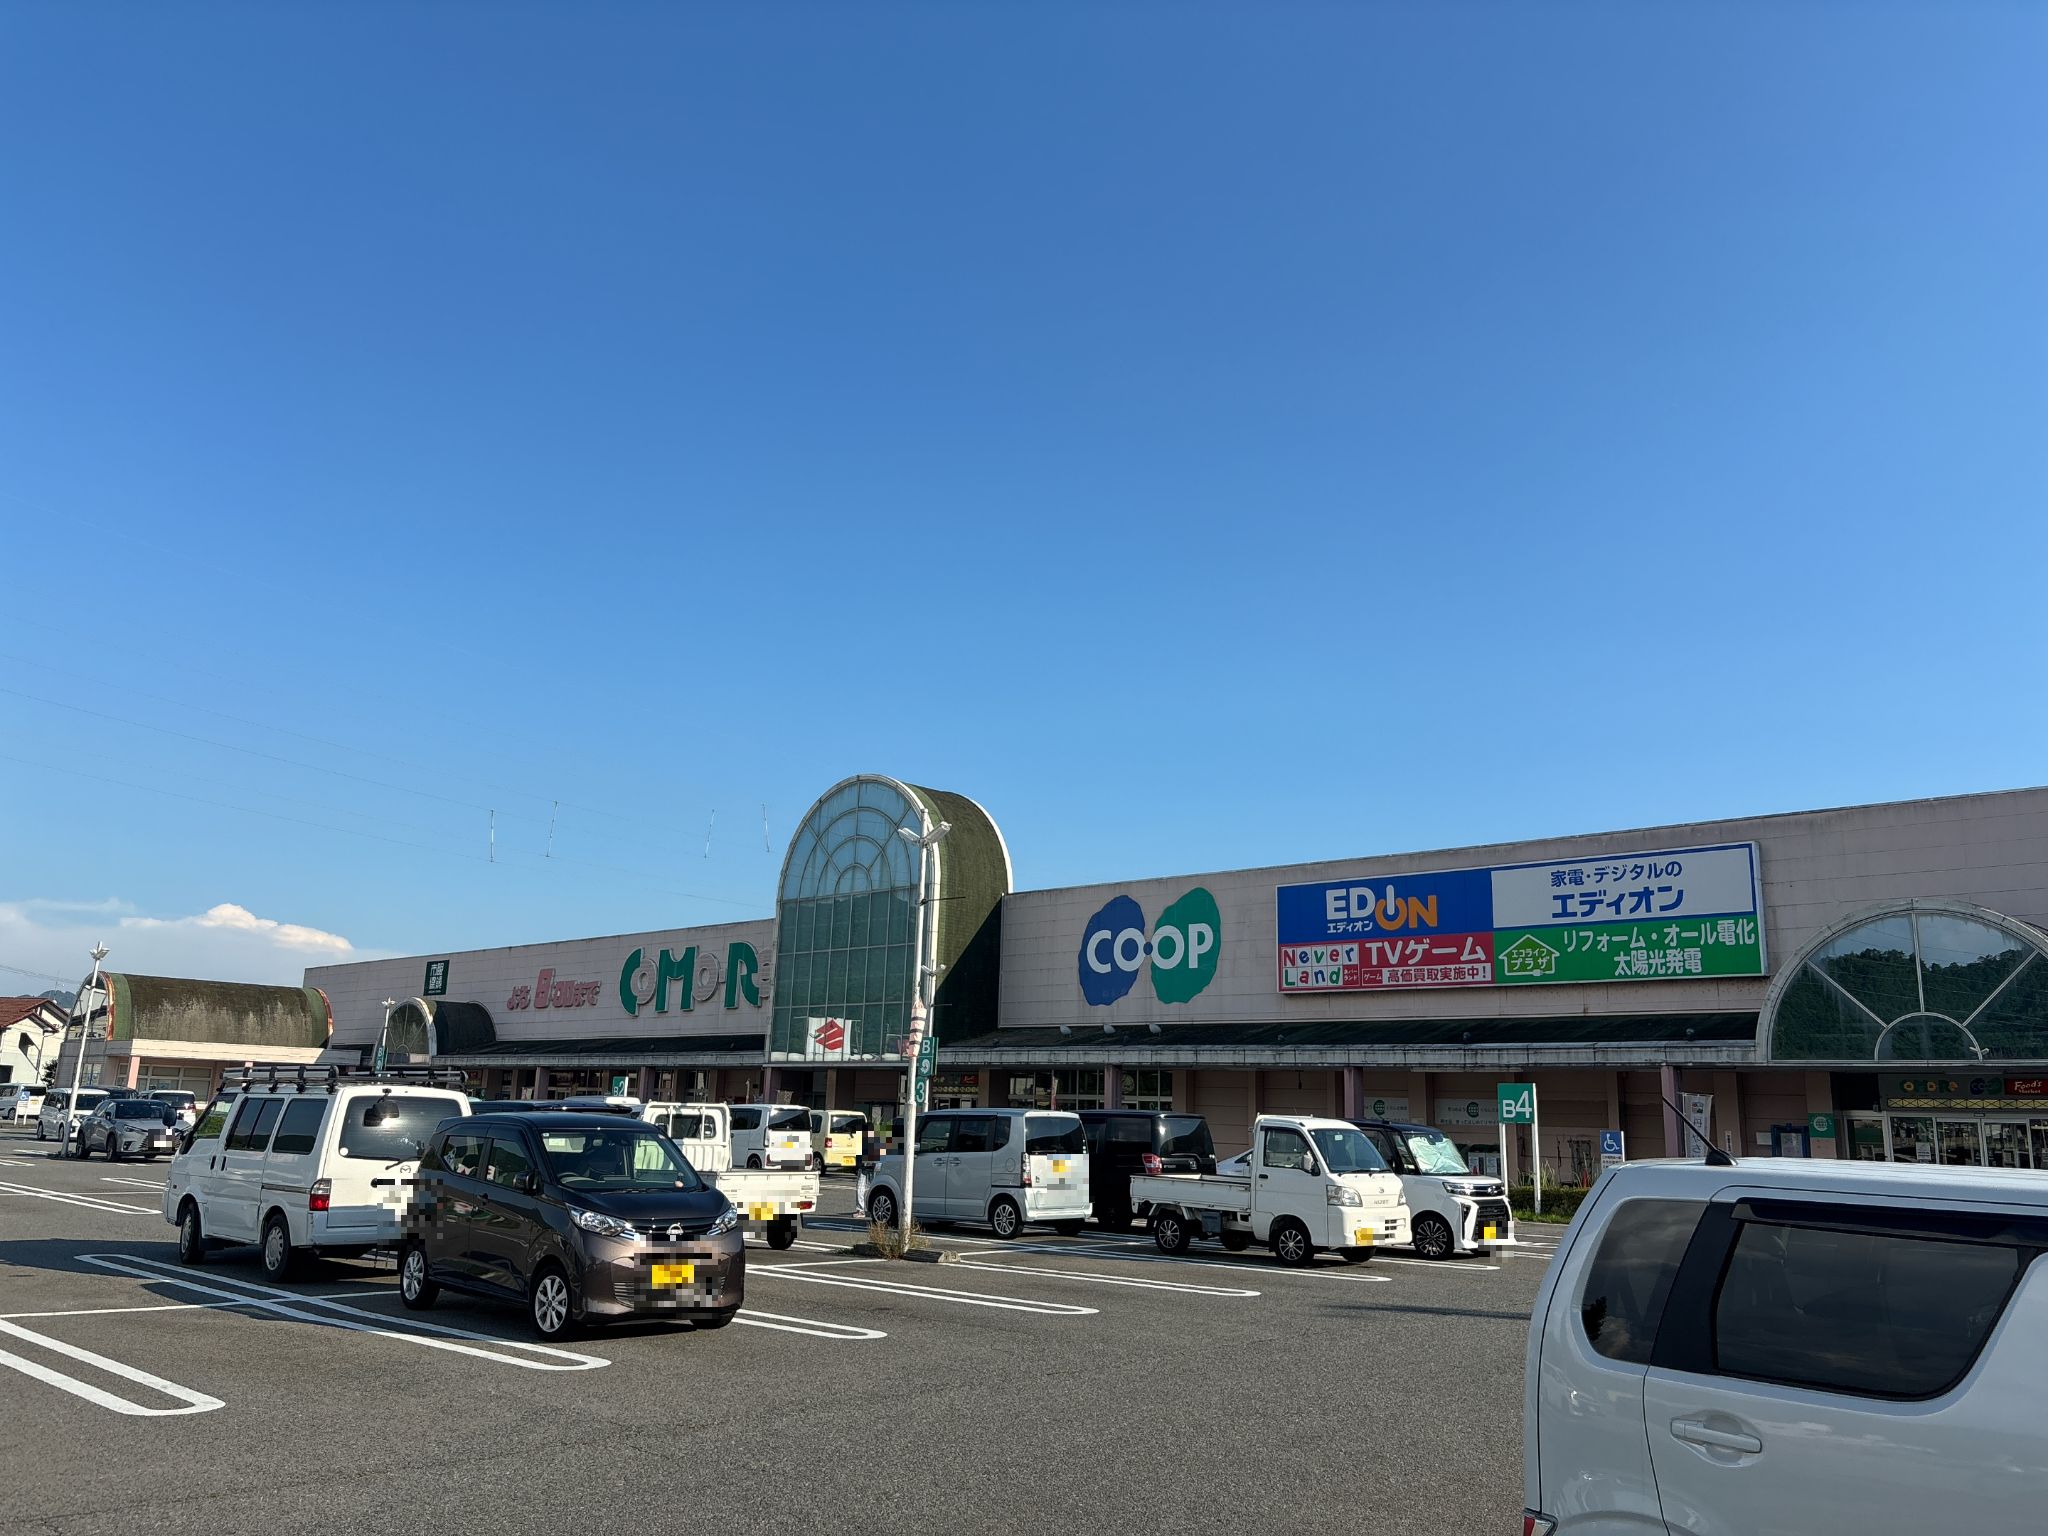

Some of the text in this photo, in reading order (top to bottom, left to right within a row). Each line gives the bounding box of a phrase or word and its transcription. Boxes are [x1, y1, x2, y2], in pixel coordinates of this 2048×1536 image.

[1551, 861, 1683, 887] 家電・デジタルの
[1326, 884, 1438, 931] EDION
[1552, 885, 1684, 918] エディオン
[1327, 920, 1373, 934] エディオン
[1563, 918, 1756, 953] リフォーム・オール電化
[1283, 946, 1355, 967] Never
[1365, 936, 1486, 966] TVゲーム
[1511, 948, 1548, 958] エコライフ
[1511, 956, 1549, 970] プラザ
[1614, 947, 1702, 977] 太陽光発電
[1284, 966, 1343, 986] Land
[1363, 972, 1383, 981] ゲーム
[1387, 966, 1487, 983] 高価買取実施中!
[614, 1080, 625, 1096] B2
[1502, 1090, 1533, 1119] B4
